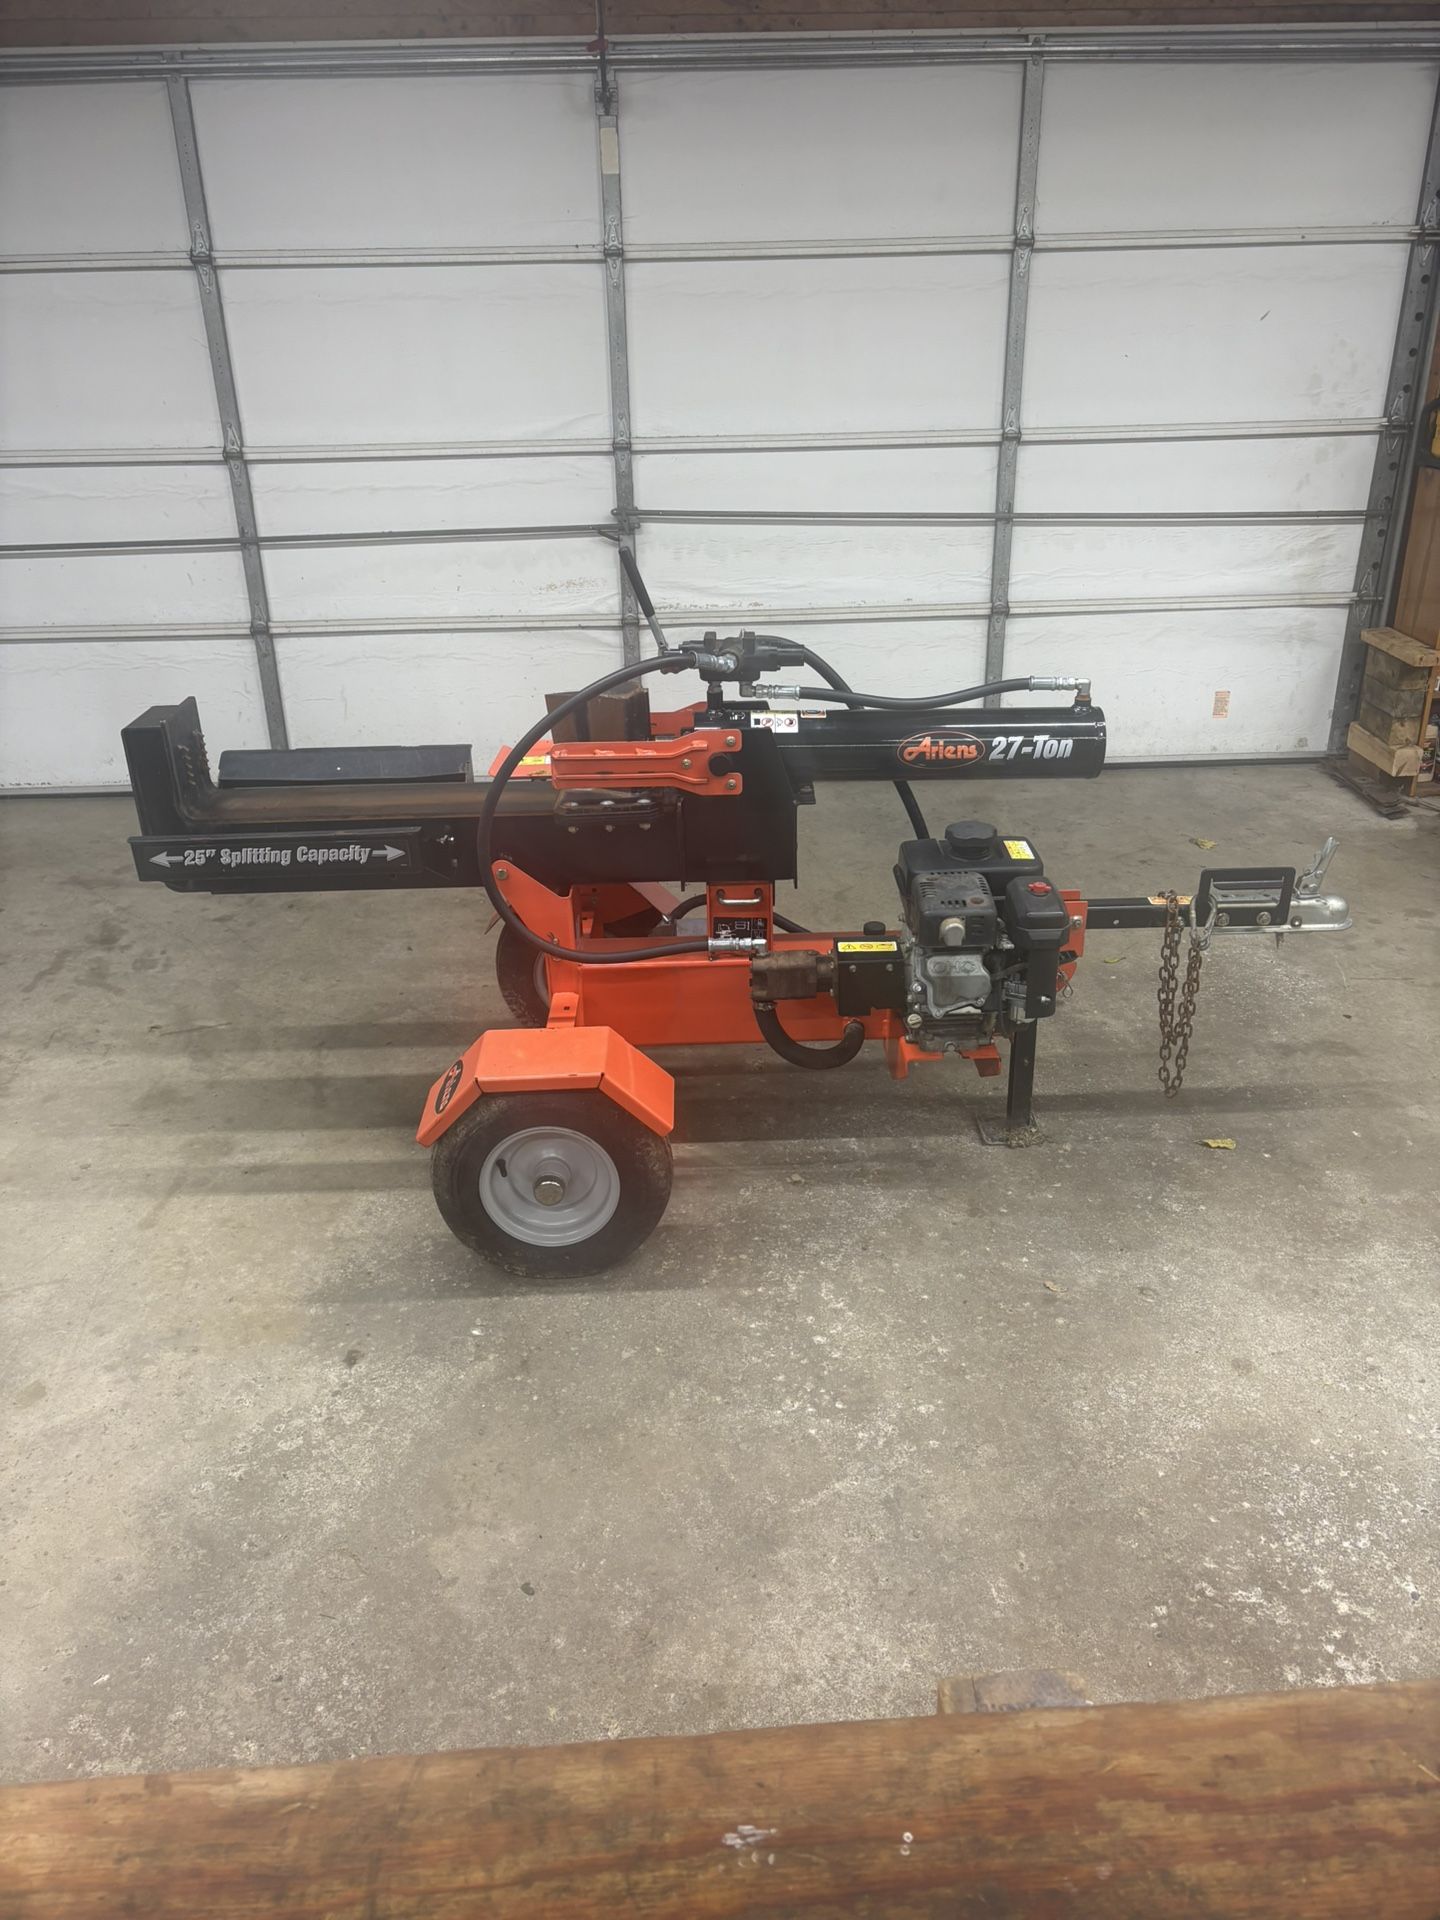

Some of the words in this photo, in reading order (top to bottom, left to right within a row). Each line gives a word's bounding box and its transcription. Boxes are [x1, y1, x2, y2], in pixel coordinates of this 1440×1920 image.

[903, 736, 978, 761] Ariens
[989, 735, 1074, 761] 27-Ton
[183, 849, 215, 866] 25"
[220, 847, 292, 868] Splitting
[296, 845, 371, 865] Capacity
